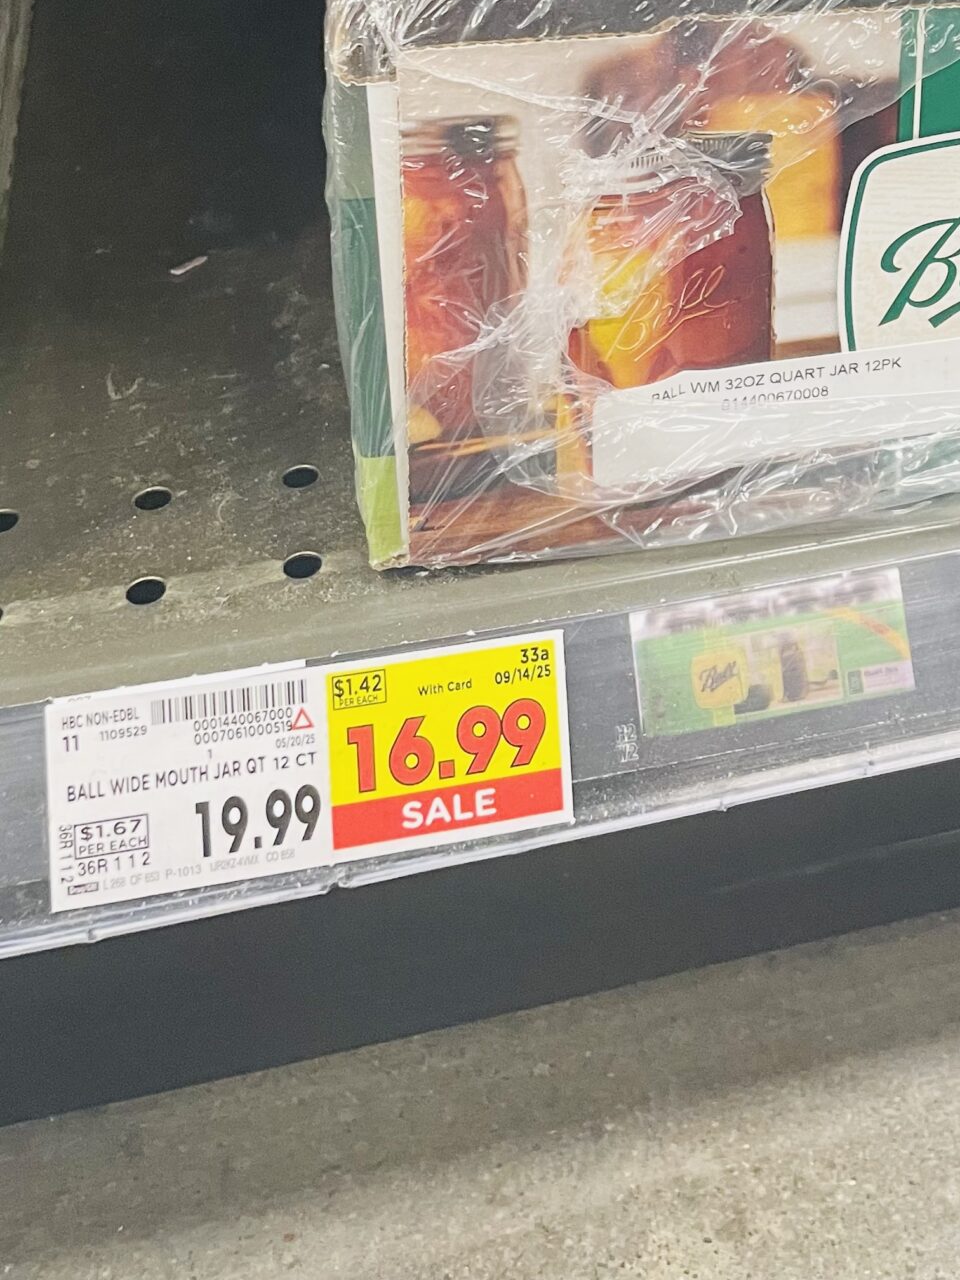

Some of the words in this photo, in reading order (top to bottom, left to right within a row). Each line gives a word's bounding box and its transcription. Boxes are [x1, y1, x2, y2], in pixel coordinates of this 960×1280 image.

[605, 265, 734, 362] Ball
[690, 380, 721, 395] WM
[769, 366, 826, 384] QUART
[829, 361, 860, 378] JAR
[864, 356, 902, 372] 12PK
[520, 646, 550, 664] 33a
[334, 673, 383, 698] $1.42
[417, 684, 444, 697] With
[447, 678, 473, 692] Card
[494, 664, 552, 687] 09/14/25
[339, 696, 355, 708] PER
[356, 694, 379, 706] EACH
[61, 714, 84, 731] HBC
[85, 706, 141, 728] NON-EDBL
[193, 706, 294, 732] 0001440067000
[62, 734, 79, 753] 11
[99, 724, 148, 741] 1109529
[193, 719, 293, 746] 0007061000519
[275, 733, 316, 750] 05/20/25
[346, 697, 547, 794] 16.99
[66, 780, 106, 803] BALL
[109, 773, 151, 797] WIDE
[154, 764, 209, 790] MOUTH
[213, 759, 242, 780] JAR
[246, 756, 267, 776] QT
[274, 756, 290, 770] 12
[295, 751, 318, 768] CT
[195, 783, 322, 858] 19.99
[401, 787, 498, 830] SALE
[80, 818, 143, 843] $1.67
[78, 842, 105, 856] PER
[109, 834, 149, 852] EACH
[77, 858, 109, 878] 36R
[141, 850, 152, 867] 2
